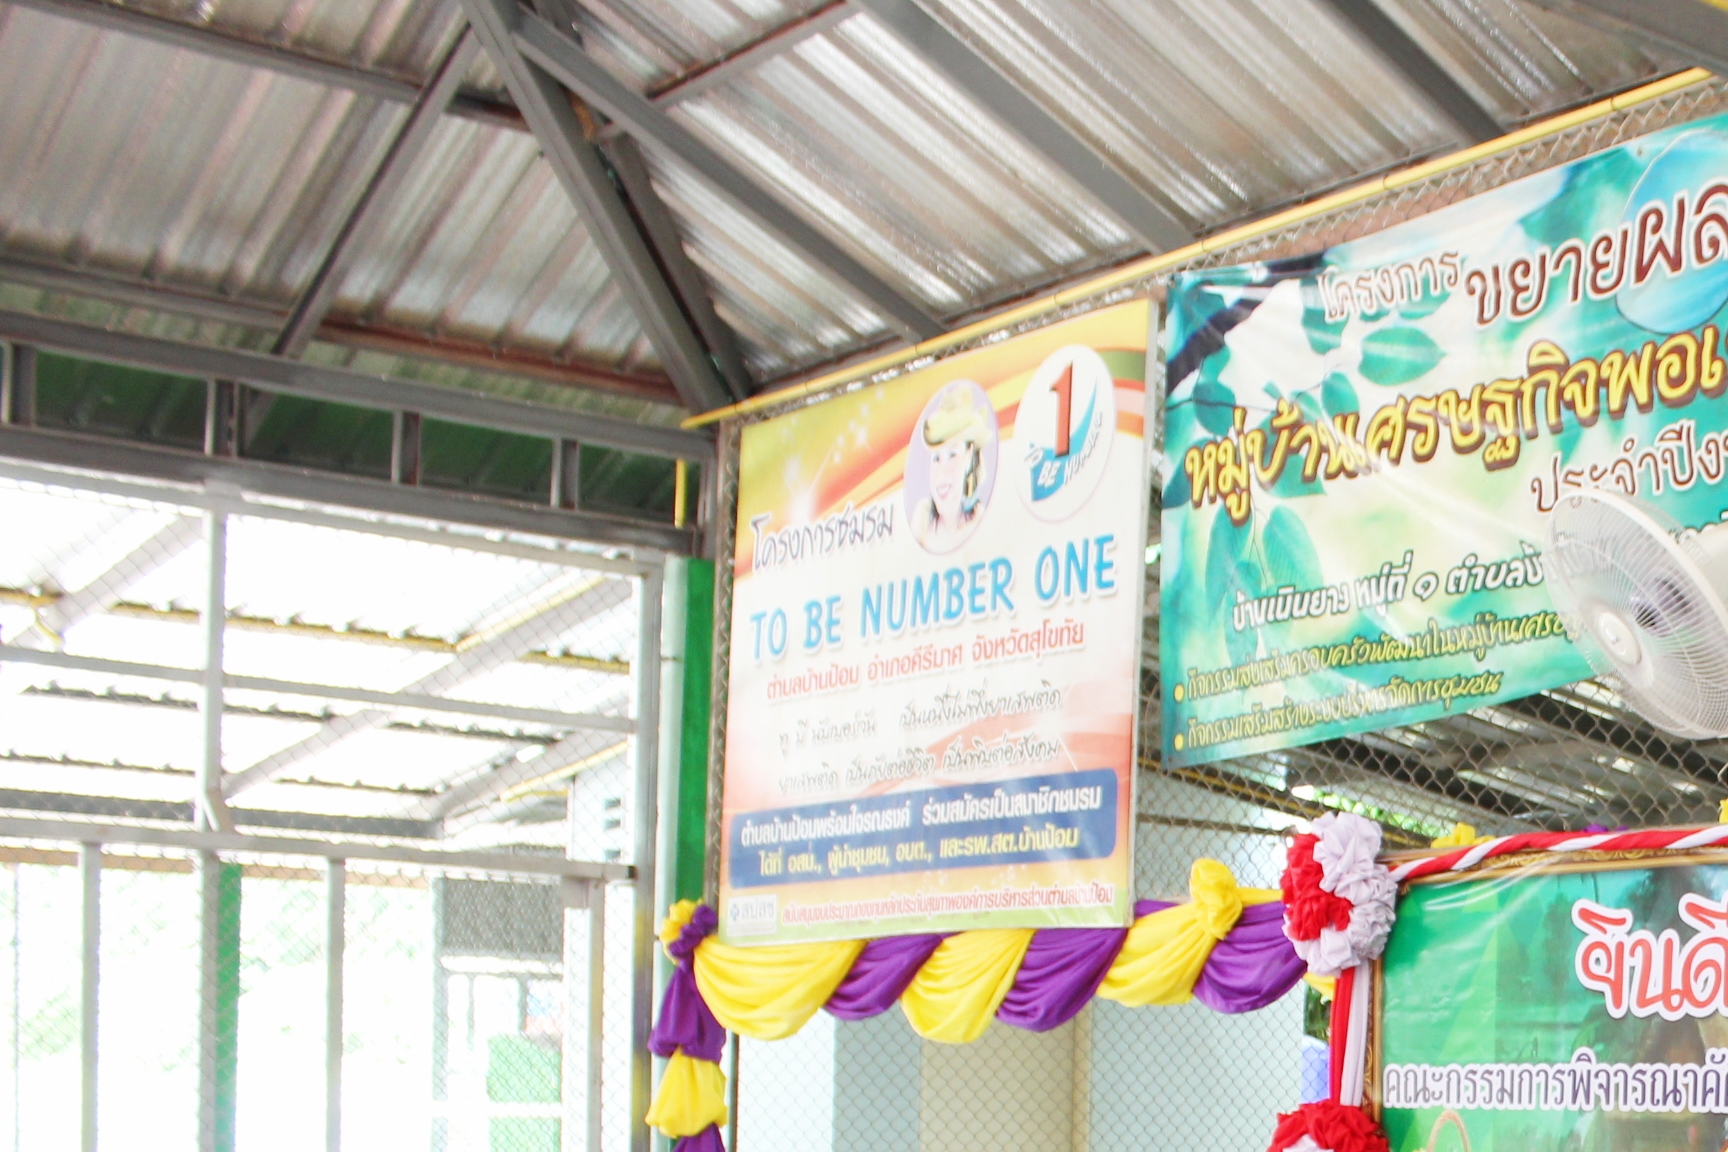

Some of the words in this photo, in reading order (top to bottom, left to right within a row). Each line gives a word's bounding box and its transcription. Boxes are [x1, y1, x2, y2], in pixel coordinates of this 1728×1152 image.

[1317, 250, 1460, 323] โครงการ
[750, 503, 894, 571] โครงการชมรม
[750, 607, 788, 661] TO
[803, 595, 842, 649] BE
[860, 556, 1015, 638] NUMBER
[1034, 534, 1115, 601] ONE
[766, 661, 860, 701] ตำบลบ้านป้อม
[867, 640, 964, 682] อำเภอคีรีมาศ
[971, 618, 1085, 662] จังหวัดสุโขทัย
